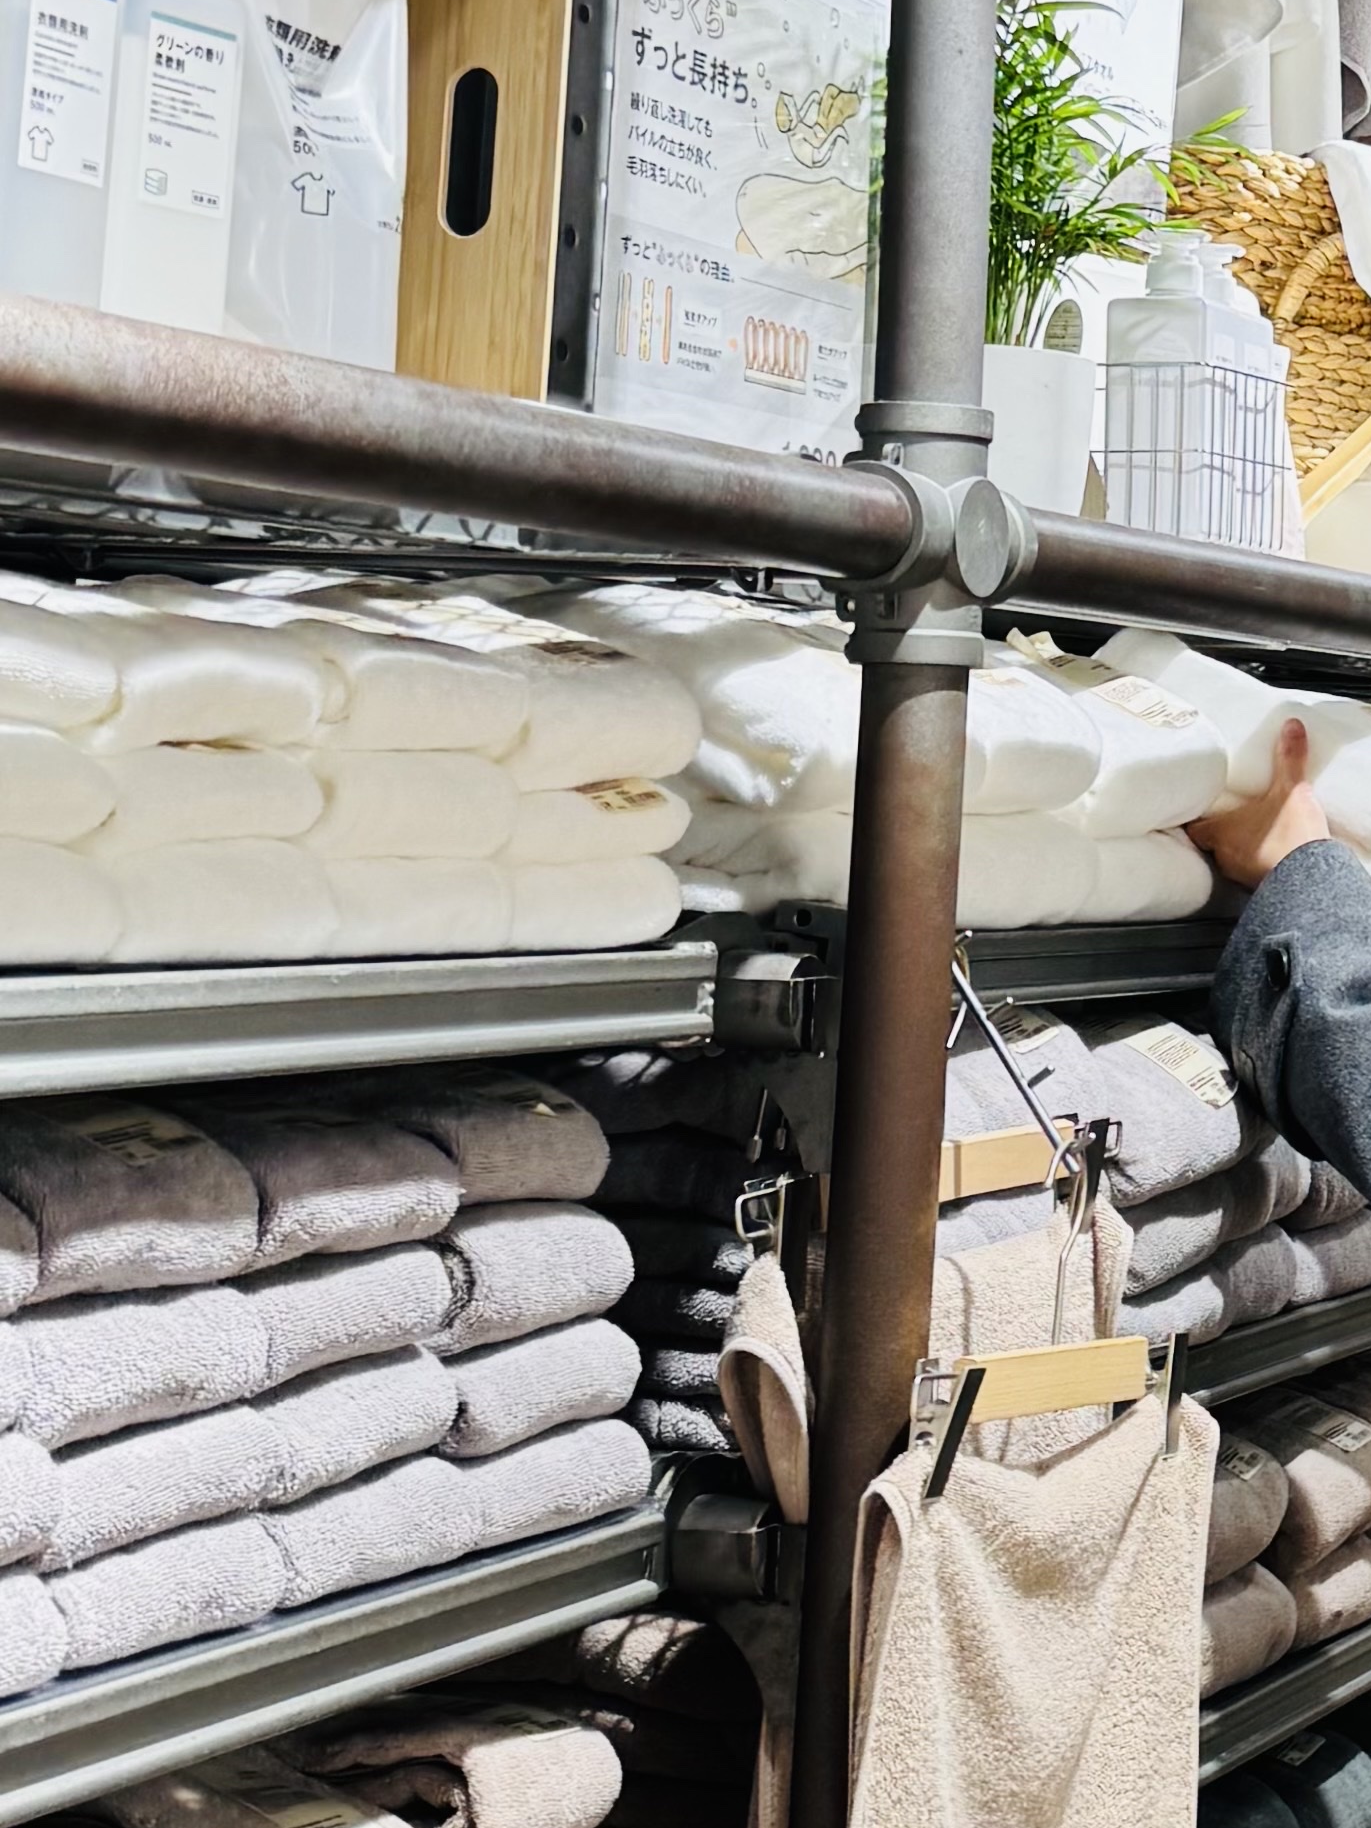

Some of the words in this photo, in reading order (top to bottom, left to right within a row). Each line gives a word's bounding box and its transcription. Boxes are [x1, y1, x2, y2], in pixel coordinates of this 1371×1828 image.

[156, 33, 225, 66] グリーンの香り
[632, 26, 757, 109] ずっと長持ち。
